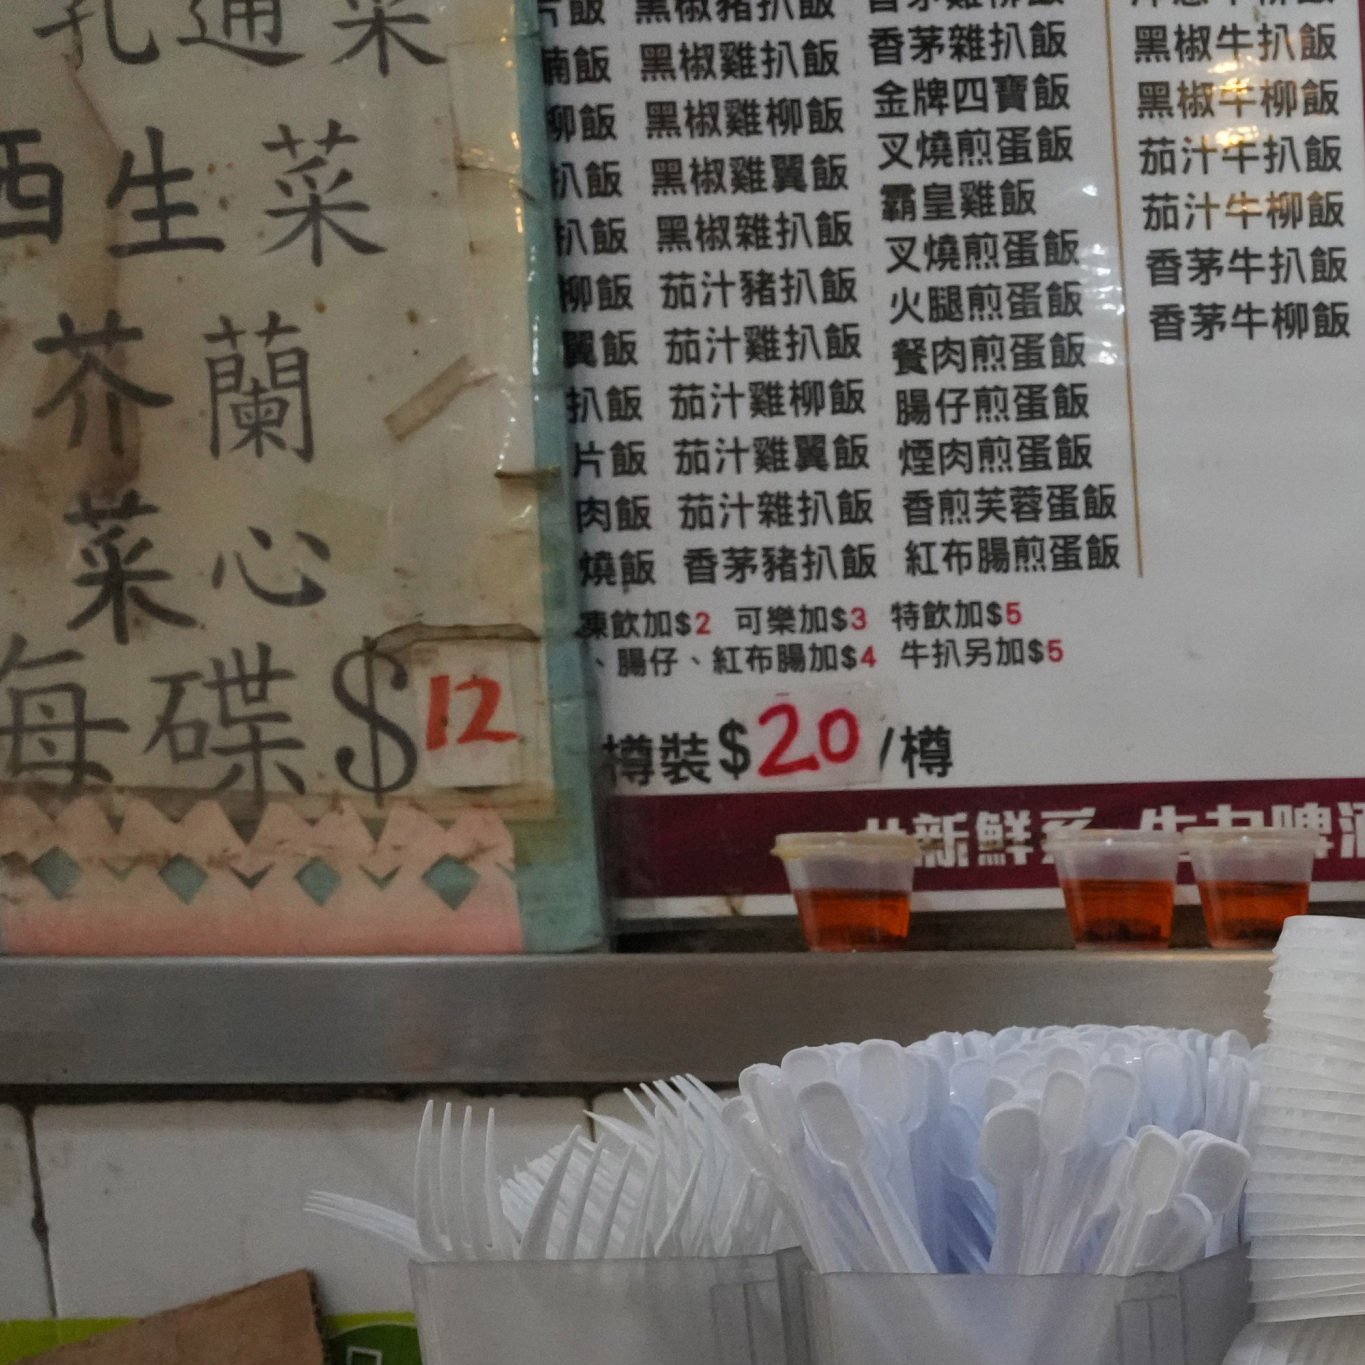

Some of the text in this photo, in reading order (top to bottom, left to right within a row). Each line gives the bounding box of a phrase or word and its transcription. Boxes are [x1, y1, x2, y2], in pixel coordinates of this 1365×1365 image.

[640, 39, 840, 82] 黑椒雞扒飯
[868, 20, 1068, 66] 香茅雜扒飯
[1134, 22, 1338, 63] 黑椒牛扒飯
[645, 96, 844, 139] 黑椒雞柳飯
[872, 73, 1071, 119] 金牌四寶飯
[1137, 78, 1340, 119] 黑椒牛柳飯
[877, 125, 1074, 171] 叉燒煎蛋飯
[1138, 134, 1343, 175] 茄汁牛扒飯
[650, 153, 848, 197] 黑椒雞翼飯
[880, 178, 1037, 222] 霸皇雞飯
[1141, 190, 1345, 231] 茄汁牛柳飯
[656, 210, 853, 253] 黑椒雜扒飯
[884, 229, 1080, 274] 叉燒煎蛋飯
[658, 266, 858, 310] 茄汁豬扒飯
[1146, 246, 1348, 287] 香茅牛扒飯
[890, 280, 1084, 325] 火腿煎蛋飯
[1149, 301, 1351, 342] 香茅牛柳飯
[663, 322, 862, 366] 茄汁雞扒飯
[892, 332, 1087, 377] 餐肉煎蛋飯
[34, 310, 315, 463] 芥蘭
[566, 385, 643, 425] 扒飯
[669, 378, 867, 421] 茄汁雞柳飯
[895, 383, 1090, 427] 腸仔煎蛋飯
[573, 440, 648, 479] 片飯
[673, 433, 870, 476] 茄汁雞翼飯
[898, 433, 1093, 477] 煙肉煎蛋飯
[575, 494, 653, 534] 肉飯
[677, 488, 875, 532] 茄汁雜扒飯
[902, 483, 1118, 527] 香煎芙蓉蛋飯
[64, 489, 331, 646] 菜心
[578, 549, 657, 588] 燒飯
[682, 543, 878, 586] 香茅豬扒飯
[905, 533, 1121, 577] 紅布腸煎蛋飯
[734, 603, 868, 637] 可樂加$3
[890, 599, 1022, 632] 特飲加$5
[900, 637, 1063, 670] 牛扒另加$5
